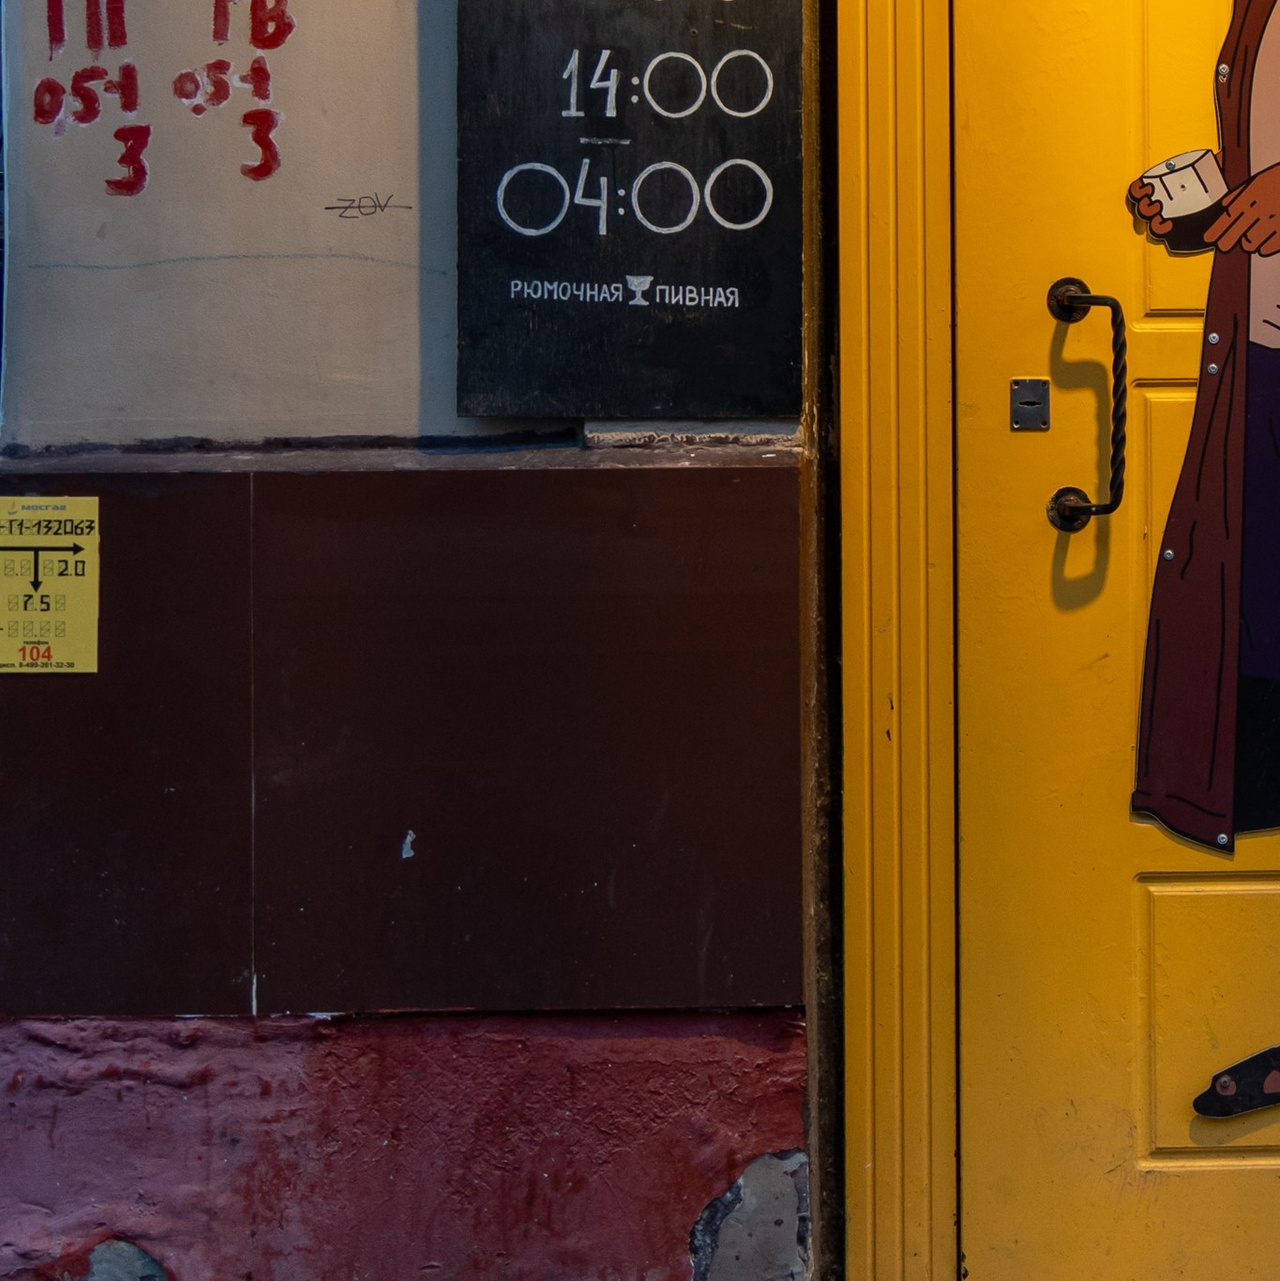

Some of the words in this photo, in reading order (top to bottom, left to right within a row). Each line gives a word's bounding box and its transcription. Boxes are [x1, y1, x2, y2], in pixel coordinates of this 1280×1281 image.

[561, 49, 774, 119] 14:00
[105, 124, 152, 196] 3
[240, 108, 283, 181] 3
[497, 158, 774, 236] 04:00
[510, 280, 623, 302] РЮМОЧНАЯ
[656, 284, 739, 307] ПИВНАЯ
[18, 645, 53, 662] 104
